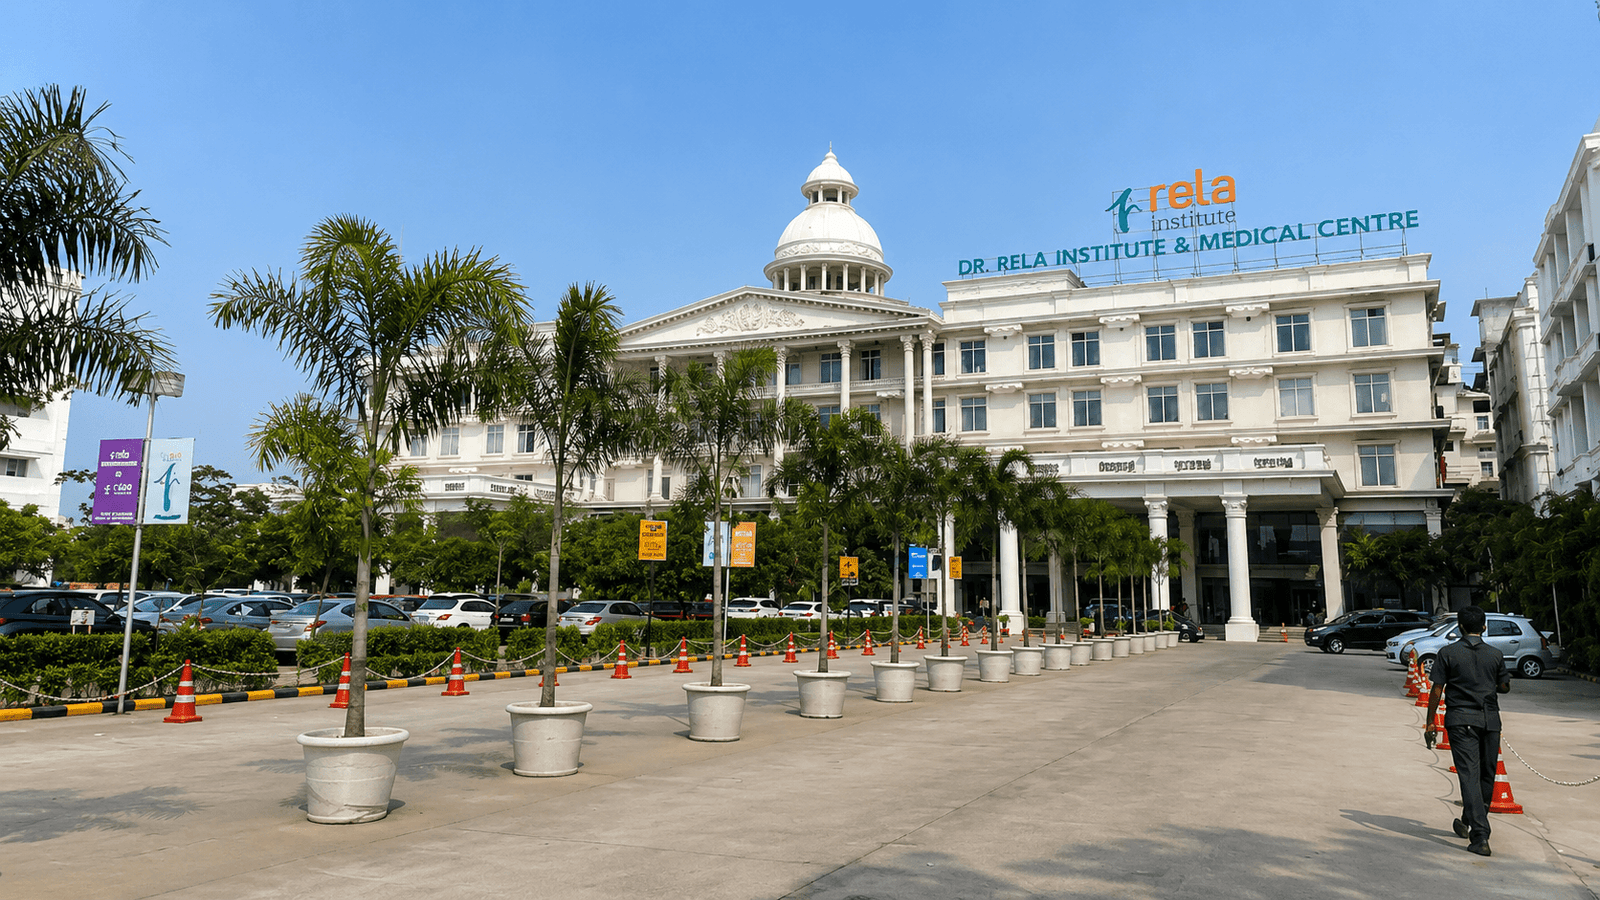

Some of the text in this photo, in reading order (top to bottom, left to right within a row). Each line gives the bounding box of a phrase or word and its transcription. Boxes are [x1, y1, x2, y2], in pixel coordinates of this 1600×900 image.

[1149, 168, 1236, 212] rela
[958, 209, 1419, 275] DR. RELA INSTITUTE & MEDICAL CENTRE
[1151, 209, 1236, 231] institute
